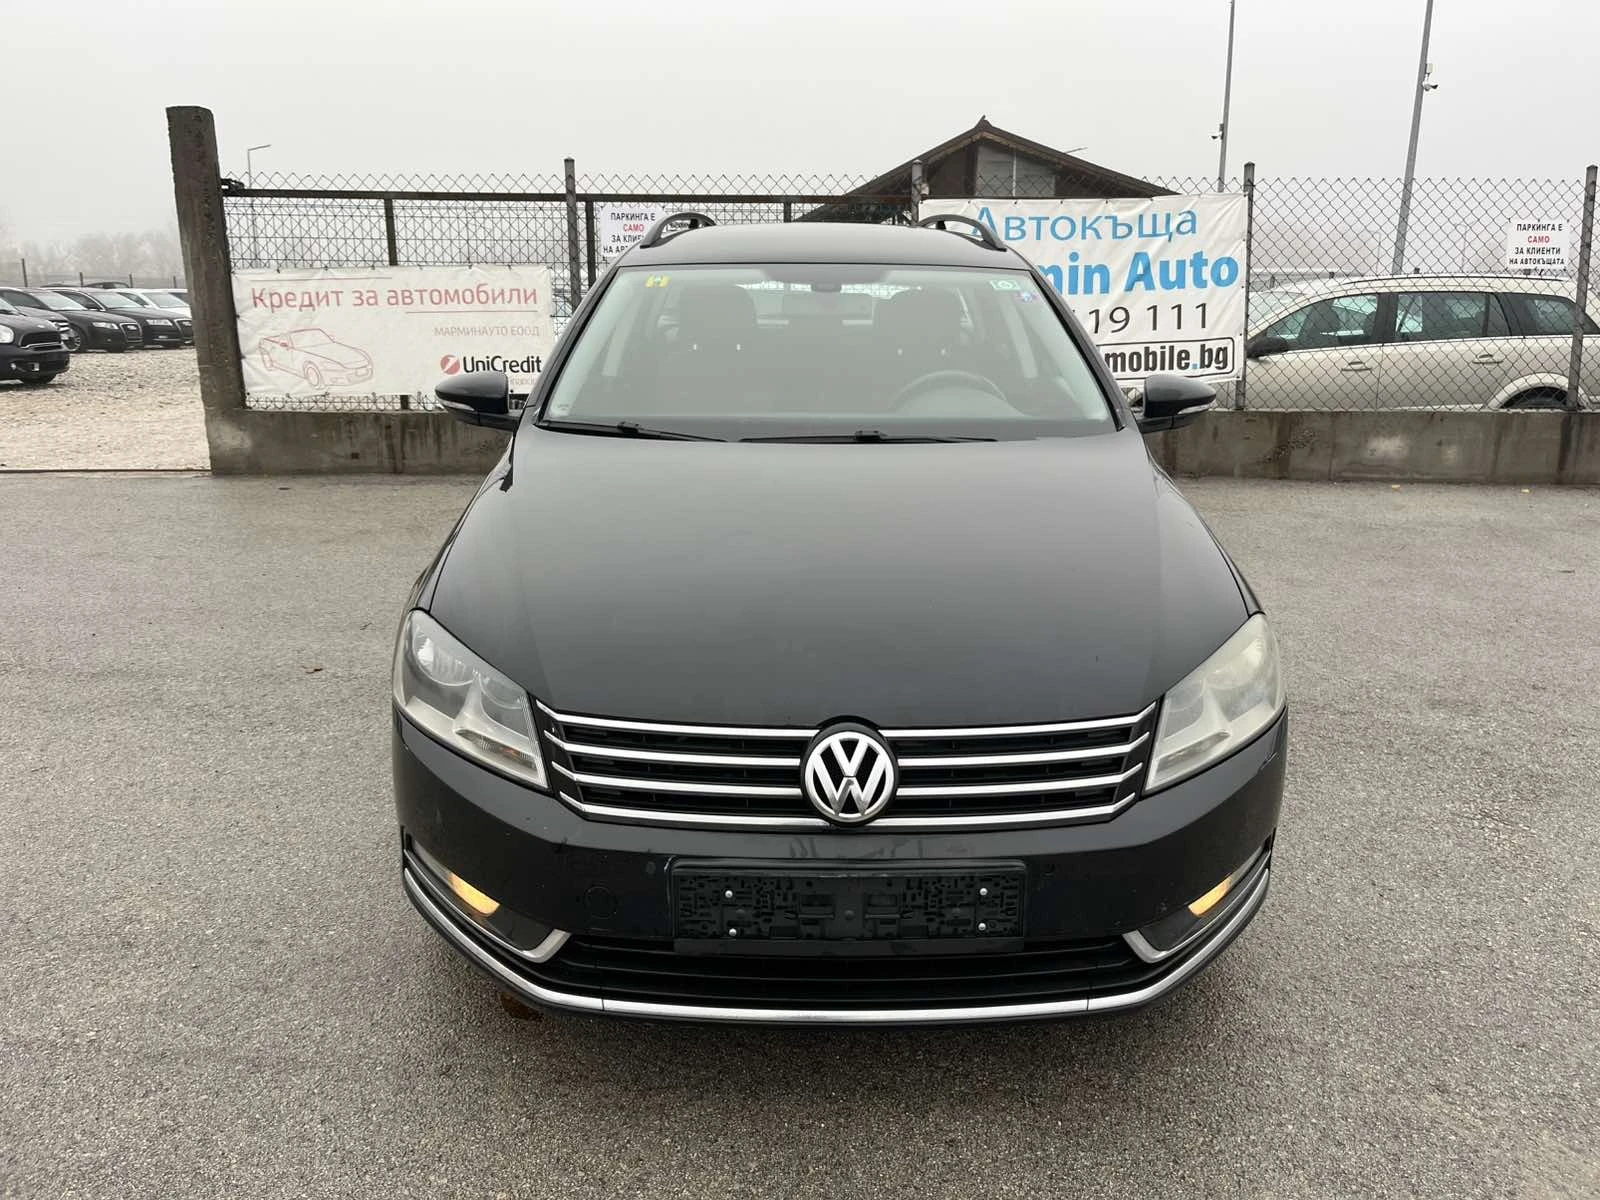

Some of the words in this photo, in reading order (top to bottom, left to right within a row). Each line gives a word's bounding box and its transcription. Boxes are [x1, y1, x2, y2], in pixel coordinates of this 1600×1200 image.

[610, 212, 650, 221] ПАРКИНГА
[623, 223, 645, 232] САМО
[971, 207, 1198, 243] Автокъща
[1516, 223, 1556, 232] ПАРКИНГА
[1557, 223, 1563, 232] Е
[611, 235, 621, 243] ЗА
[623, 234, 645, 243] КЛИЕ
[1527, 235, 1550, 244] САМО
[603, 245, 614, 253] НА
[1514, 247, 1524, 255] ЗА
[1526, 247, 1561, 255] КЛИЕНТИ
[1520, 257, 1565, 265] АВТОКЪЩАТА
[1124, 250, 1239, 292] Auto
[251, 287, 344, 314] Кредит
[352, 289, 379, 307] за
[386, 282, 537, 306] автомобили
[1146, 303, 1207, 331] 111
[510, 325, 540, 337] ЕООД
[462, 354, 542, 374] UniCredit
